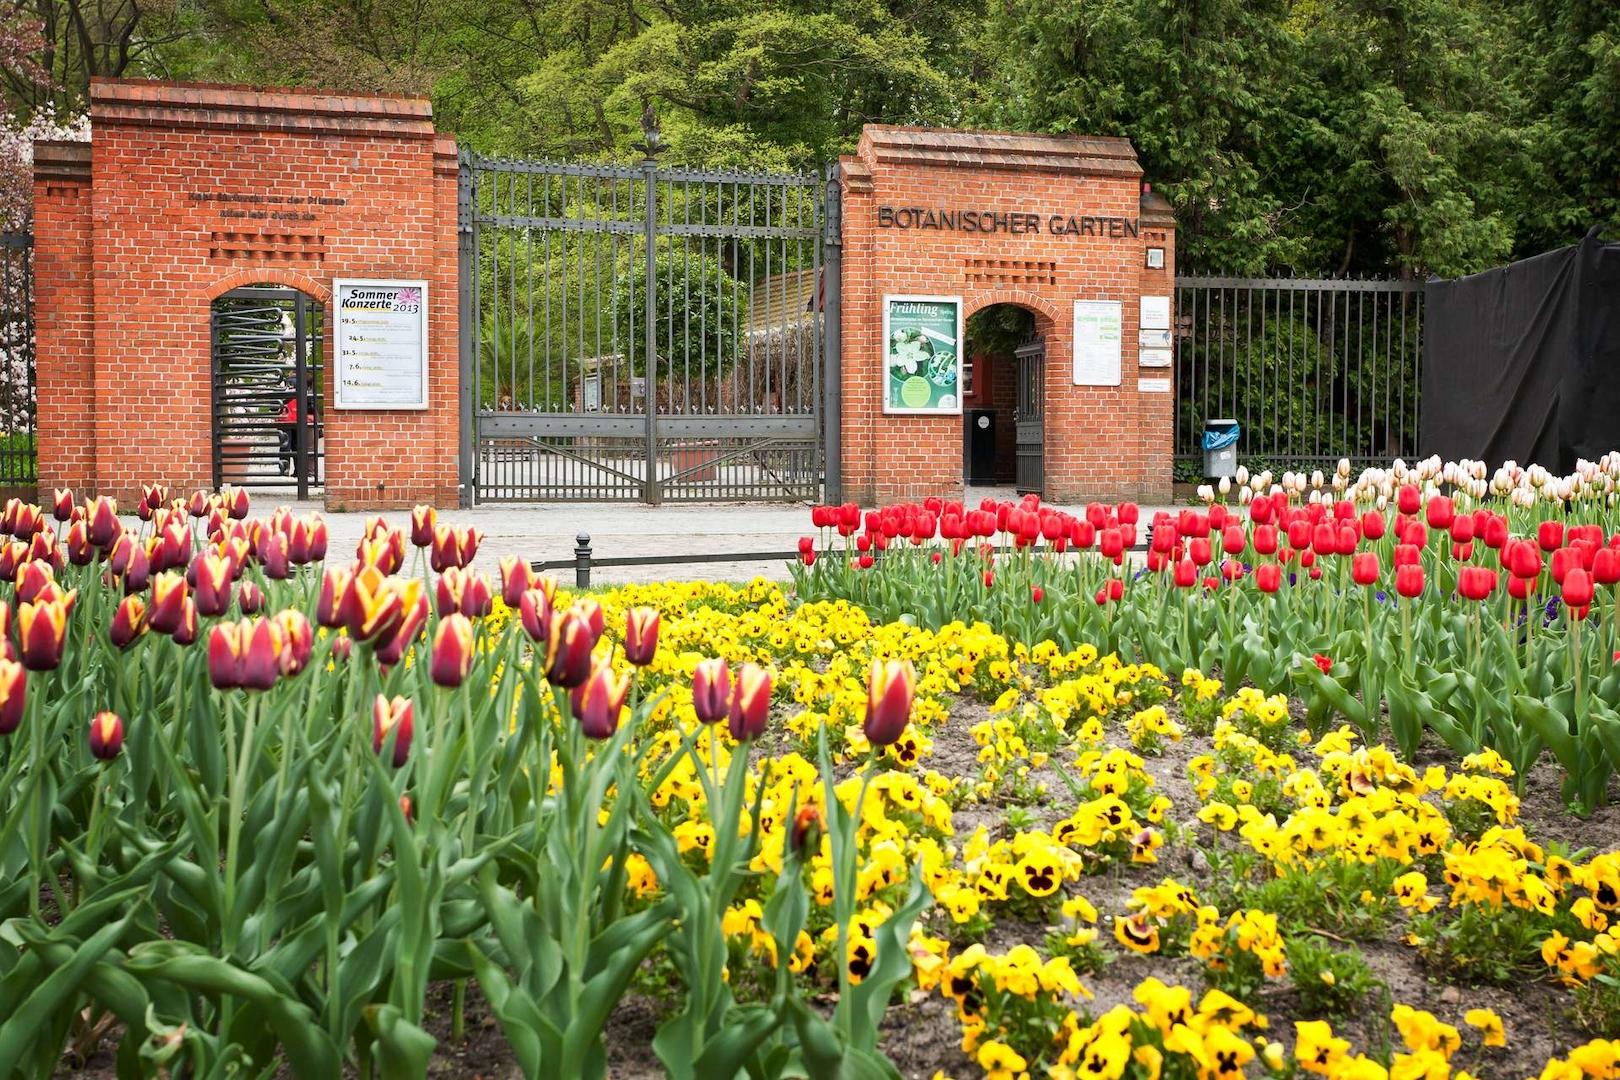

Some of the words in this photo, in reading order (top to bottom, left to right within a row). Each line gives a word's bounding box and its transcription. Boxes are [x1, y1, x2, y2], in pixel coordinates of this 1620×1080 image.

[878, 206, 1040, 234] BOTANISCHER
[1049, 215, 1140, 238] GARTEN
[350, 289, 398, 300] Sommer
[342, 299, 392, 309] Konzerte
[393, 304, 419, 314] 2013
[889, 303, 938, 316] Frühling
